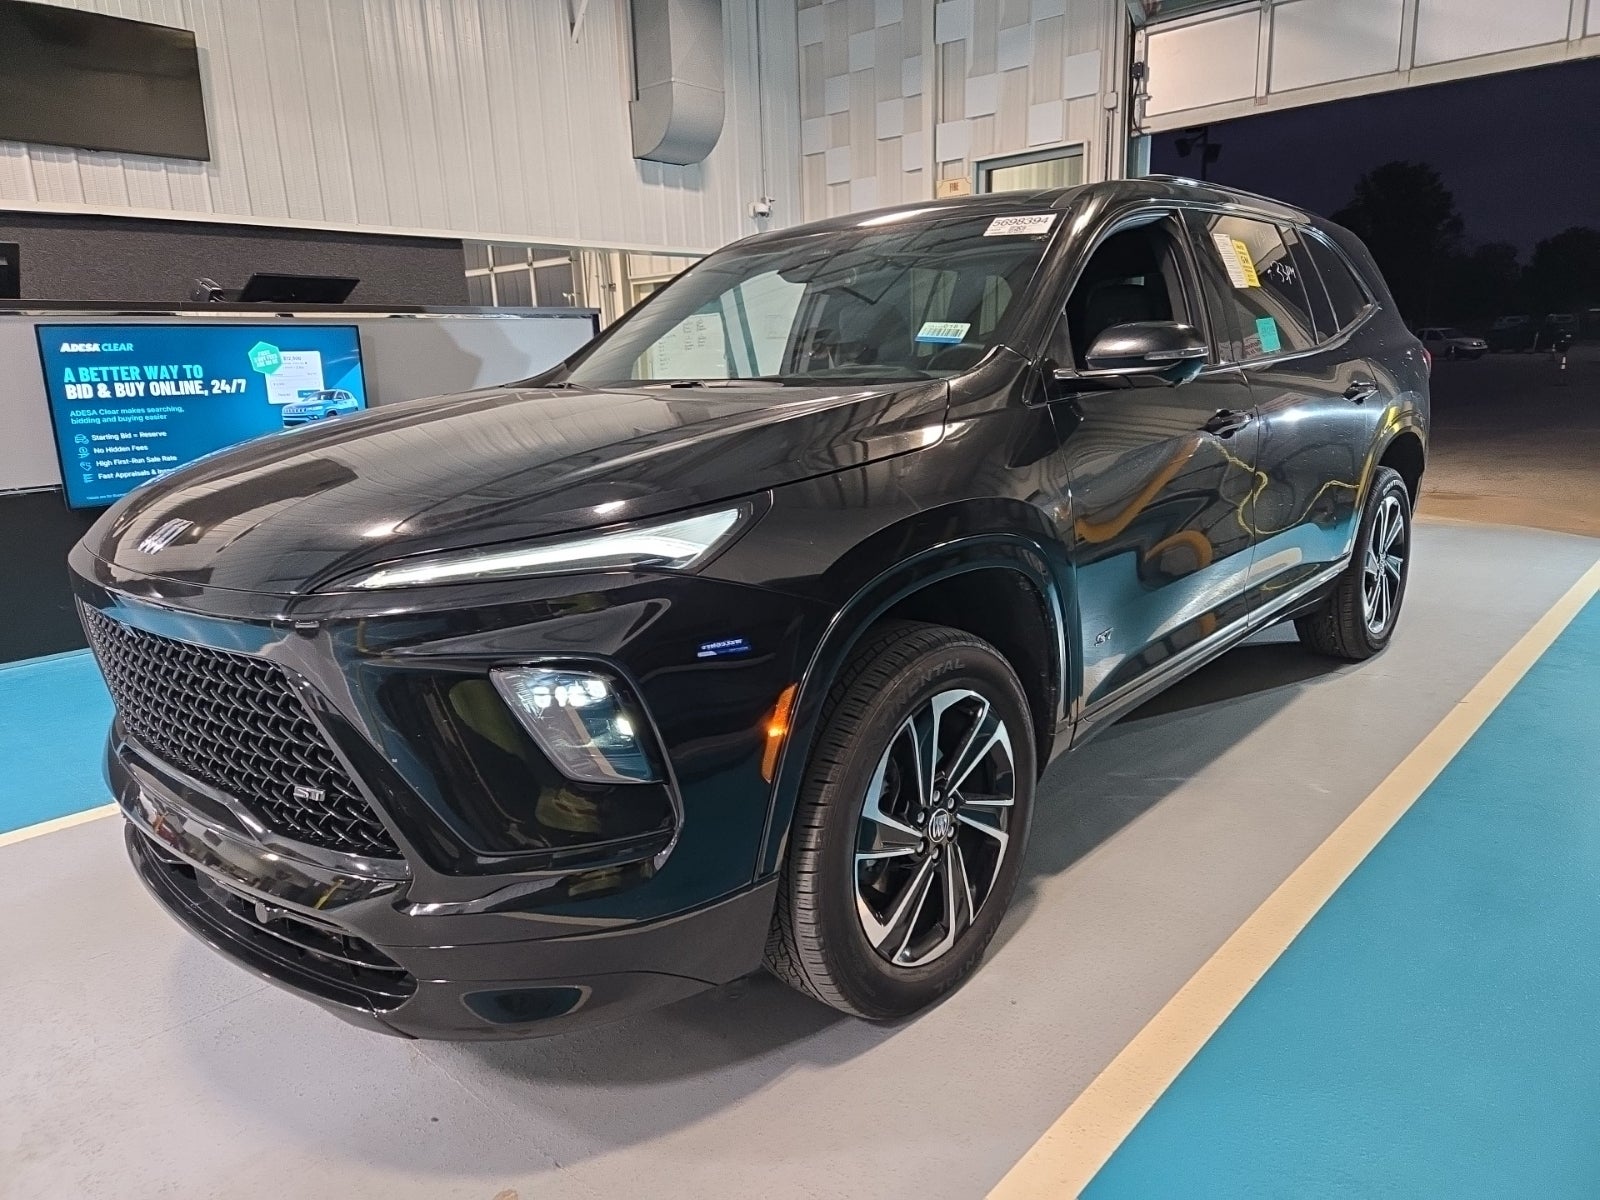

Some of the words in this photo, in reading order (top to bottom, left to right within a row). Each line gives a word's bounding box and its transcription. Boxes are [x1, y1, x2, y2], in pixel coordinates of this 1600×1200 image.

[992, 217, 1049, 227] 5698394
[60, 342, 101, 353] ADESA
[101, 342, 134, 352] CLEAR
[64, 367, 76, 383] A
[78, 366, 142, 382] BETTER
[143, 364, 179, 380] WAY
[182, 364, 204, 379] TO
[65, 383, 94, 400] BID
[97, 382, 112, 398] &
[114, 381, 145, 398] BUY
[150, 380, 209, 397] ONLINE,
[211, 378, 247, 394] 24/7
[70, 409, 98, 417] ADESA
[147, 405, 185, 413] searching,
[71, 417, 101, 425] bidding
[118, 414, 144, 422] buying
[91, 433, 119, 441] Starting
[106, 445, 130, 453] Hidden
[96, 460, 113, 468] High
[113, 457, 145, 466] First-Run
[115, 469, 150, 479] Appraisals
